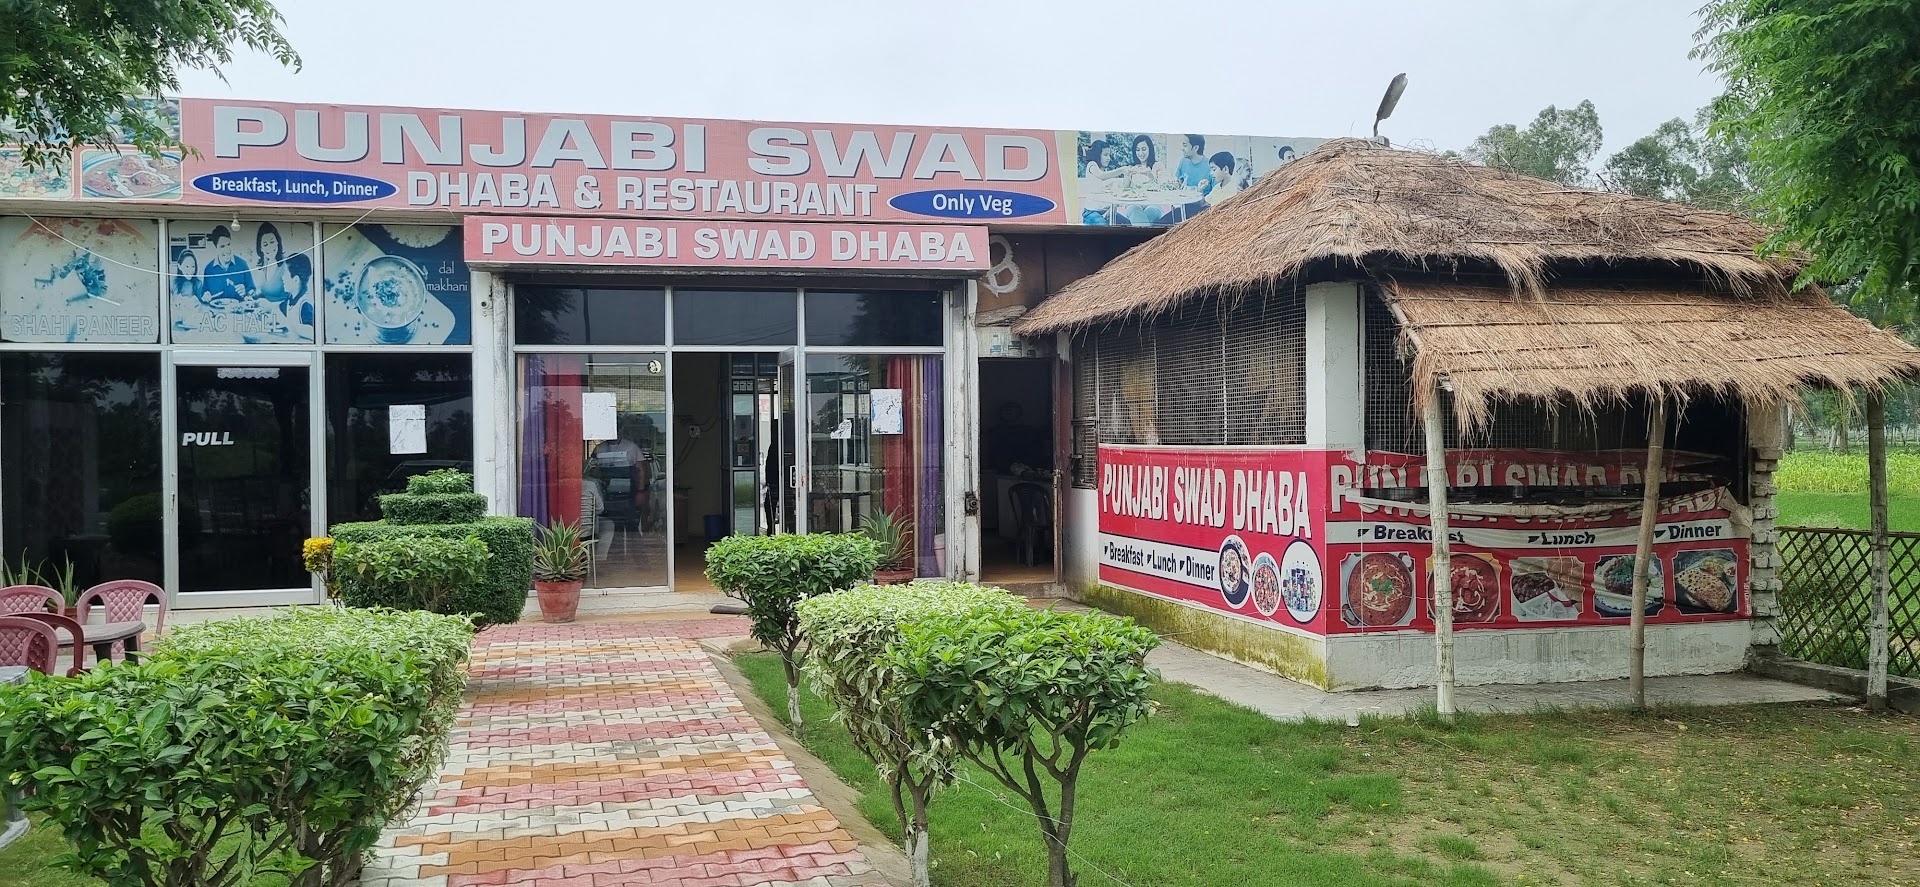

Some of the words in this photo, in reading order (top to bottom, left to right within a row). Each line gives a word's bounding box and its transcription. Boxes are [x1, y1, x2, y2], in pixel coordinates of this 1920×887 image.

[213, 105, 706, 172] PUNJABI
[747, 127, 1049, 182] SWAD
[212, 176, 281, 195] Breakfast,
[285, 179, 329, 197] Lunch,
[333, 181, 378, 196] Dinner
[408, 171, 559, 208] DHABA
[574, 175, 602, 209] &
[617, 177, 878, 216] RESTAURANT
[932, 193, 975, 215] Only
[979, 194, 1013, 216] Veg
[482, 223, 677, 258] PUNJABI
[693, 229, 816, 261] SWAD
[831, 231, 975, 263] DHABA
[438, 260, 455, 274] dal
[426, 277, 468, 291] makhani
[11, 314, 70, 336] SHAHI
[76, 315, 153, 336] PANEER
[200, 312, 227, 333] AC
[233, 312, 284, 333] HALL
[182, 431, 234, 446] PULL
[1103, 463, 1169, 521] PUNJABI
[1173, 466, 1227, 528] SWAD
[1232, 469, 1312, 539] DHABA
[1541, 531, 1596, 546] Lunch
[1668, 525, 1722, 540] Dinner
[1109, 541, 1144, 567] Breakfast
[1152, 549, 1177, 574] Lunch
[1186, 555, 1215, 581] Dinner
